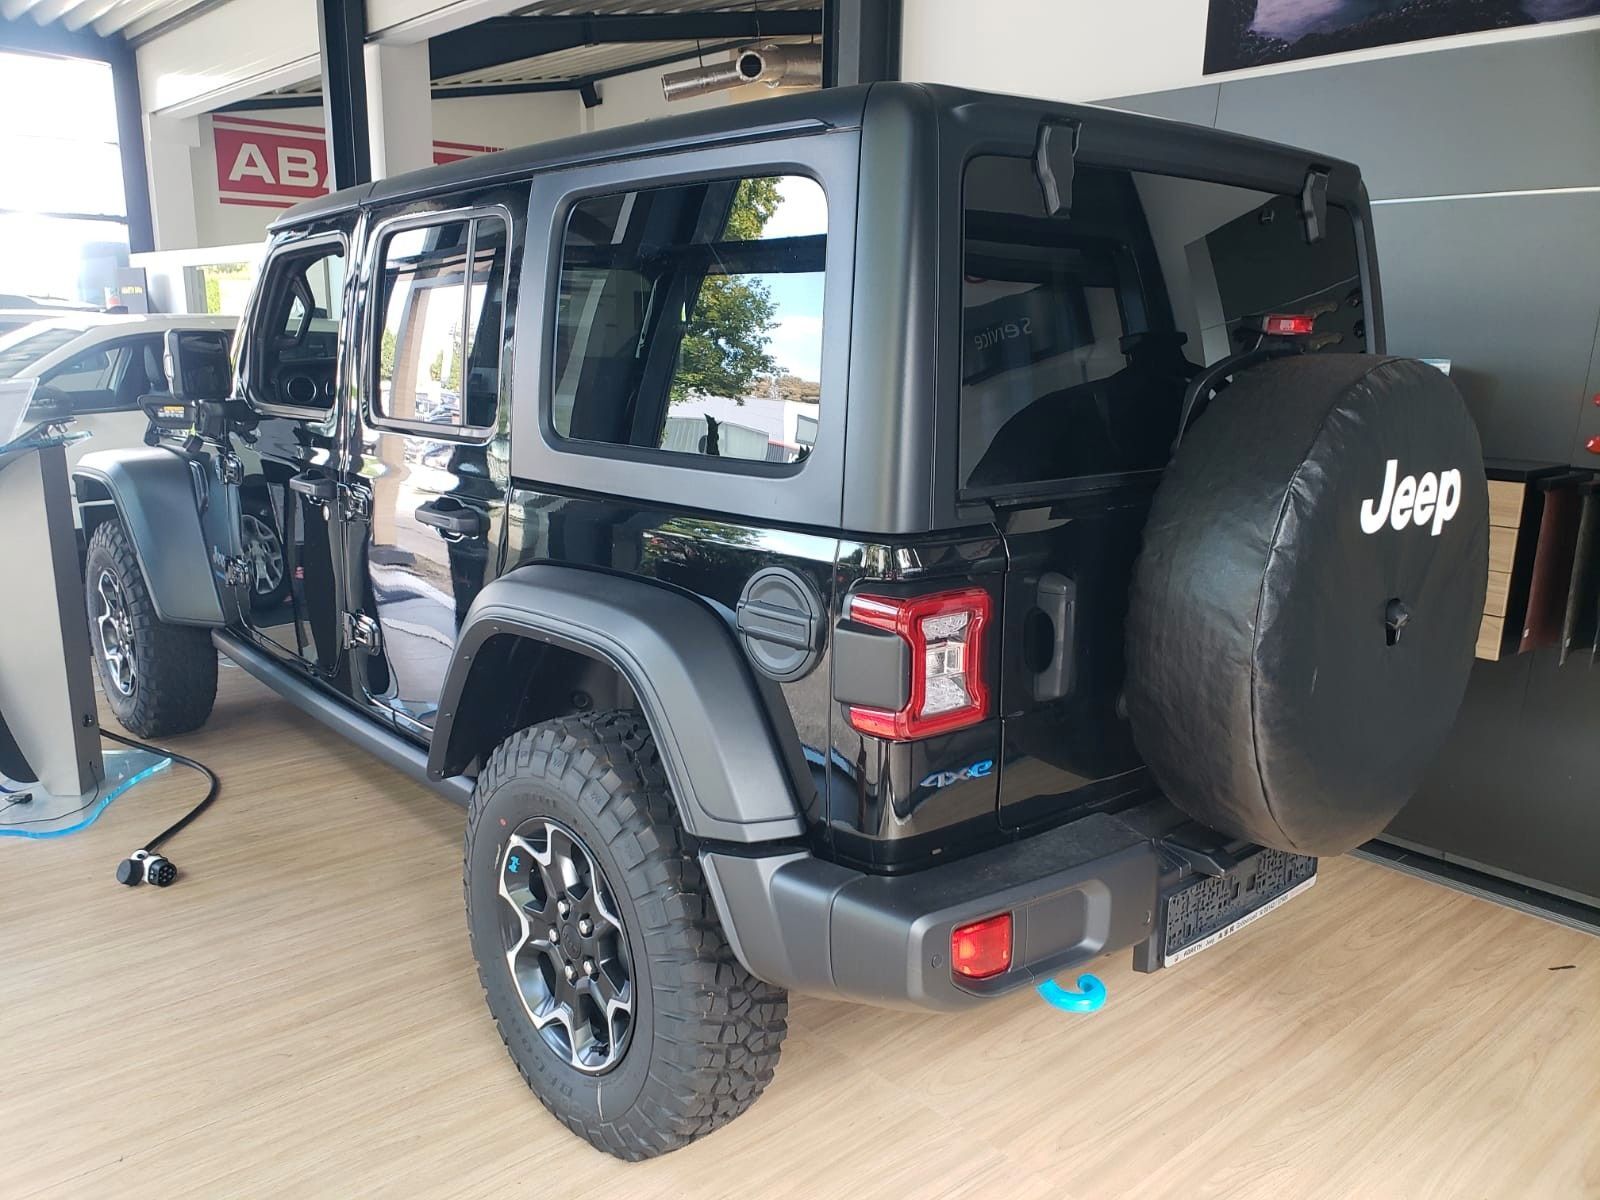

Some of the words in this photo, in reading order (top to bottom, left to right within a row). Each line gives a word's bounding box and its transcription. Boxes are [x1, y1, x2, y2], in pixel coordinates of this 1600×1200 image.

[228, 143, 329, 188] AB
[1360, 459, 1462, 537] Jeep
[919, 759, 993, 788] 4xe
